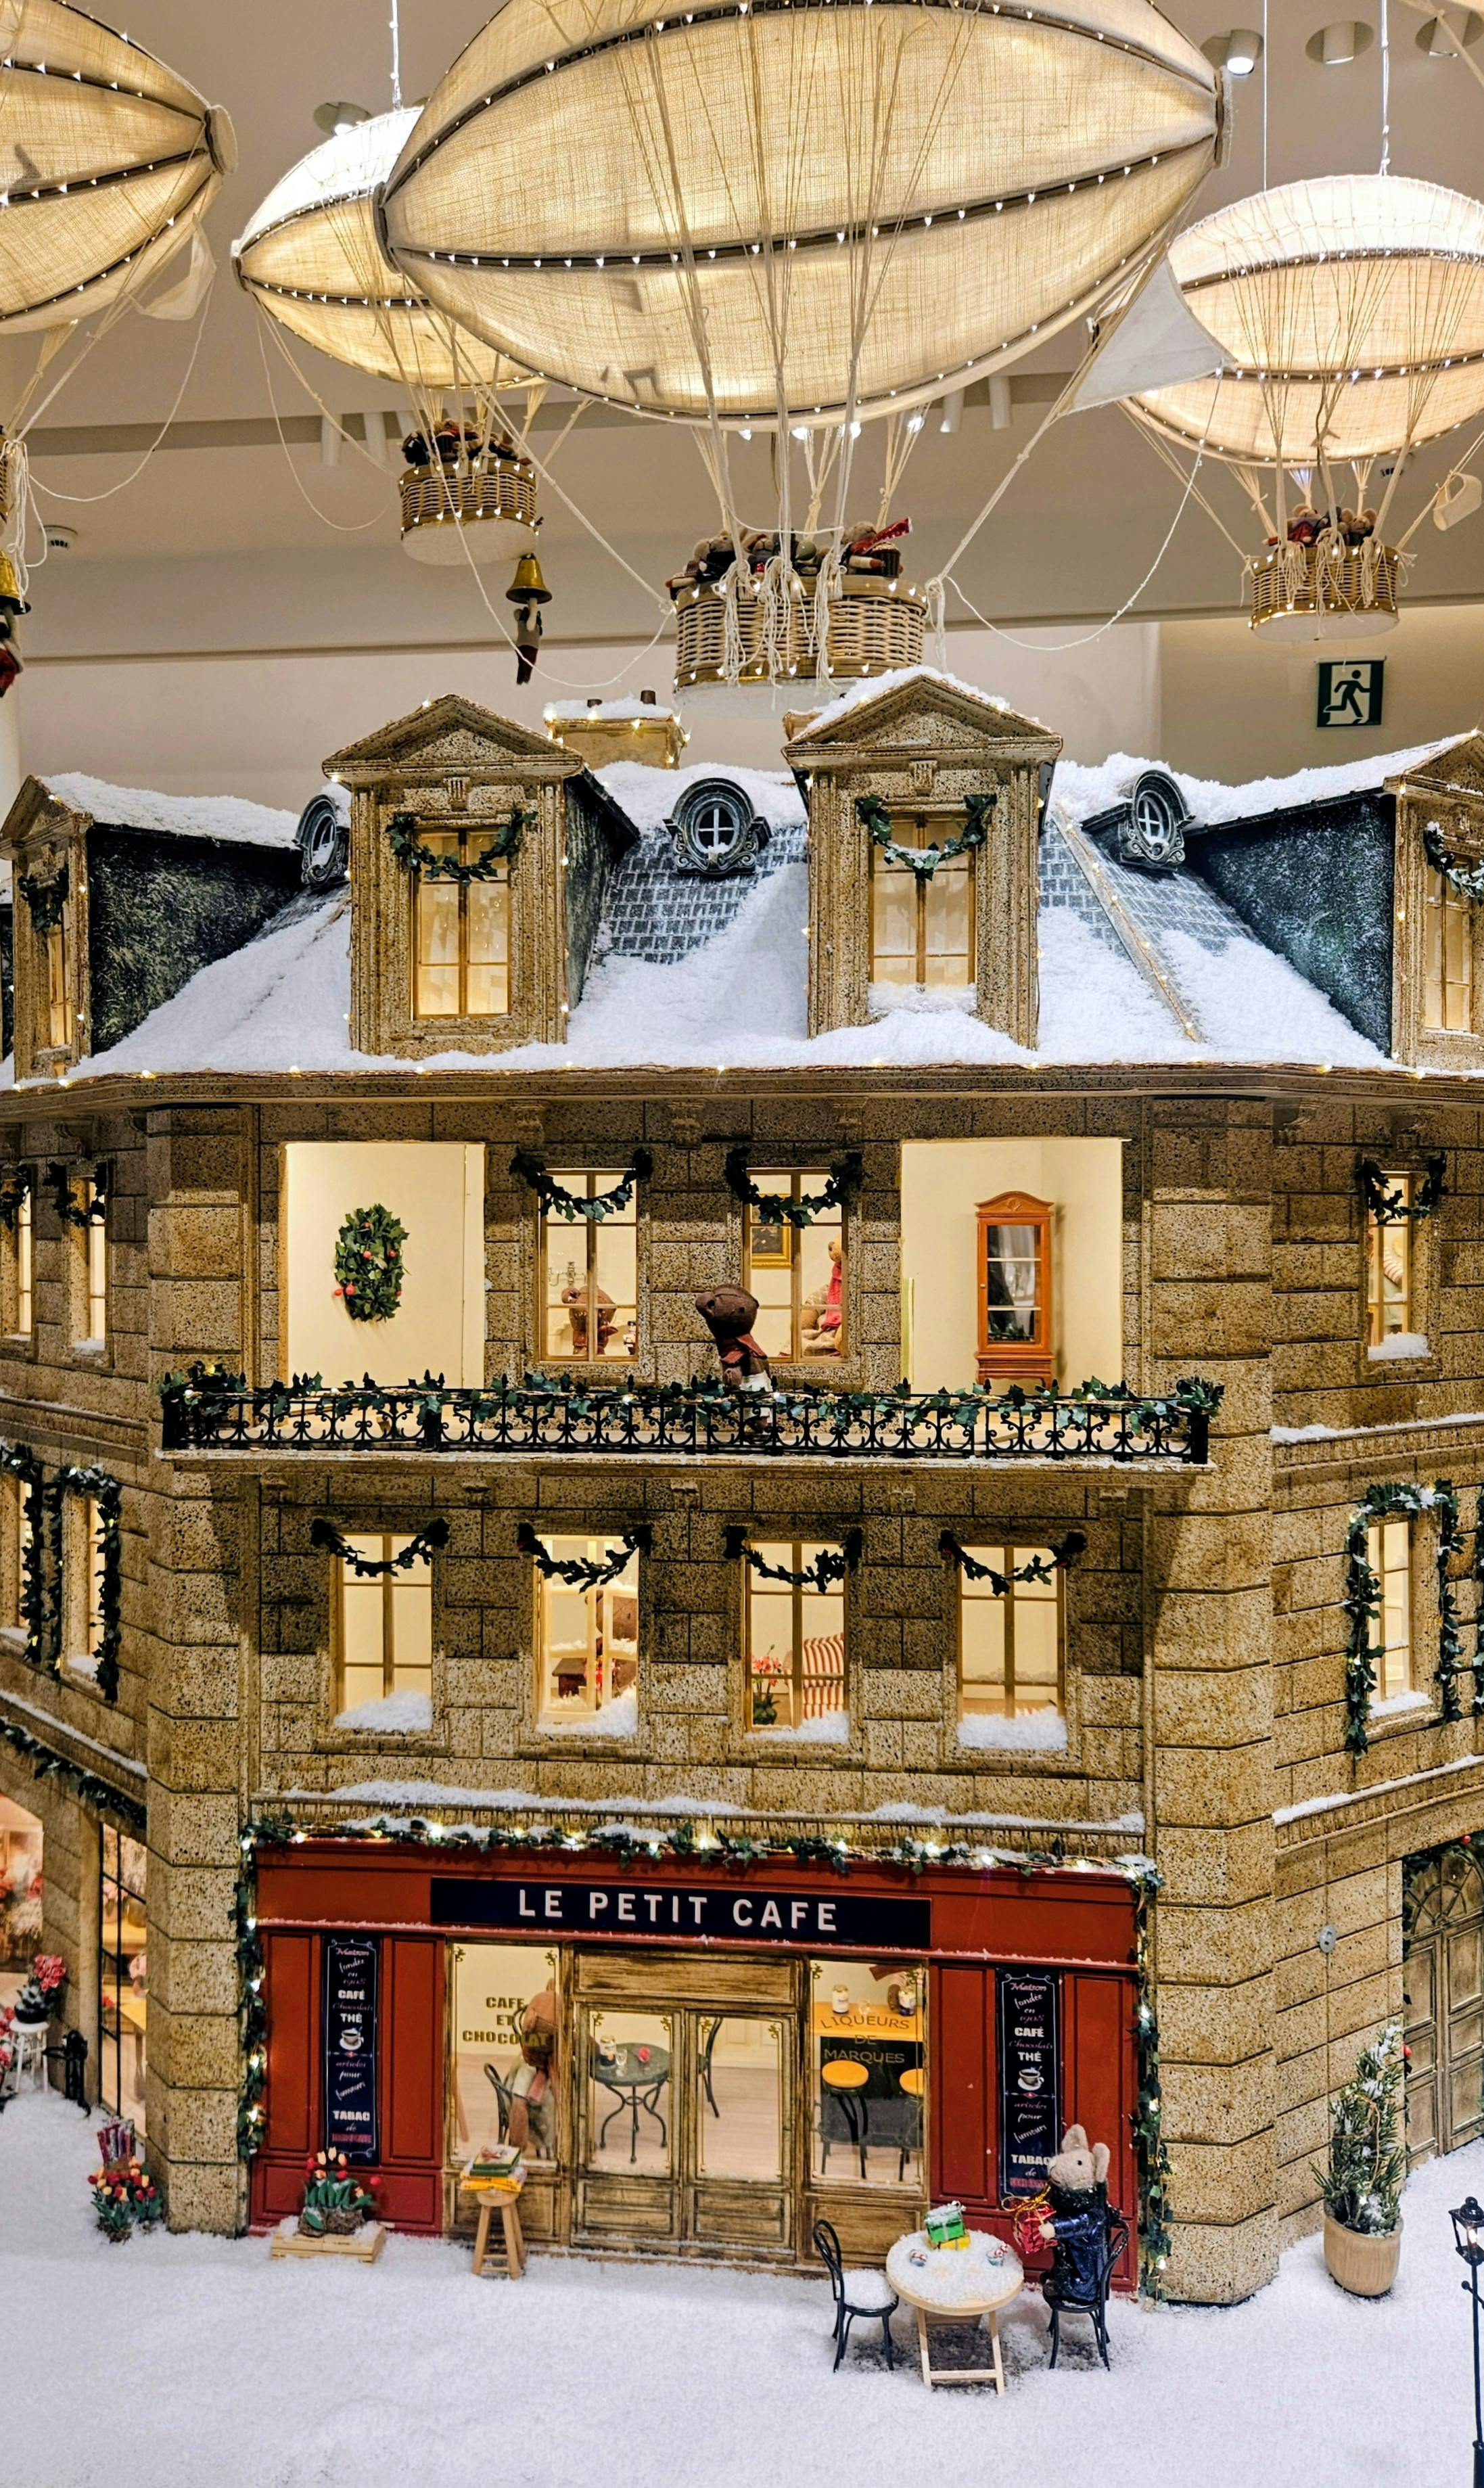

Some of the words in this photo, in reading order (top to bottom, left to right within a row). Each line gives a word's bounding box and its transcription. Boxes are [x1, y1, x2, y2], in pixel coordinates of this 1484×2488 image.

[519, 1889, 563, 1918] LE
[589, 1892, 708, 1924] PETIT
[733, 1899, 837, 1931] CAFE
[338, 1989, 365, 2000] CAFÉ
[486, 1997, 525, 2008] CAFE
[340, 2012, 363, 2023] THÉ
[496, 2014, 513, 2026] ET
[820, 2015, 910, 2030] LIQUEURS
[1015, 2027, 1044, 2037] CAFÉ
[854, 2034, 877, 2046] DE
[824, 2049, 906, 2064] MARQUES
[1017, 2051, 1042, 2062] THÉ
[332, 2110, 371, 2121] TABAC
[1017, 2113, 1042, 2123] pour
[1025, 2167, 1037, 2177] de
